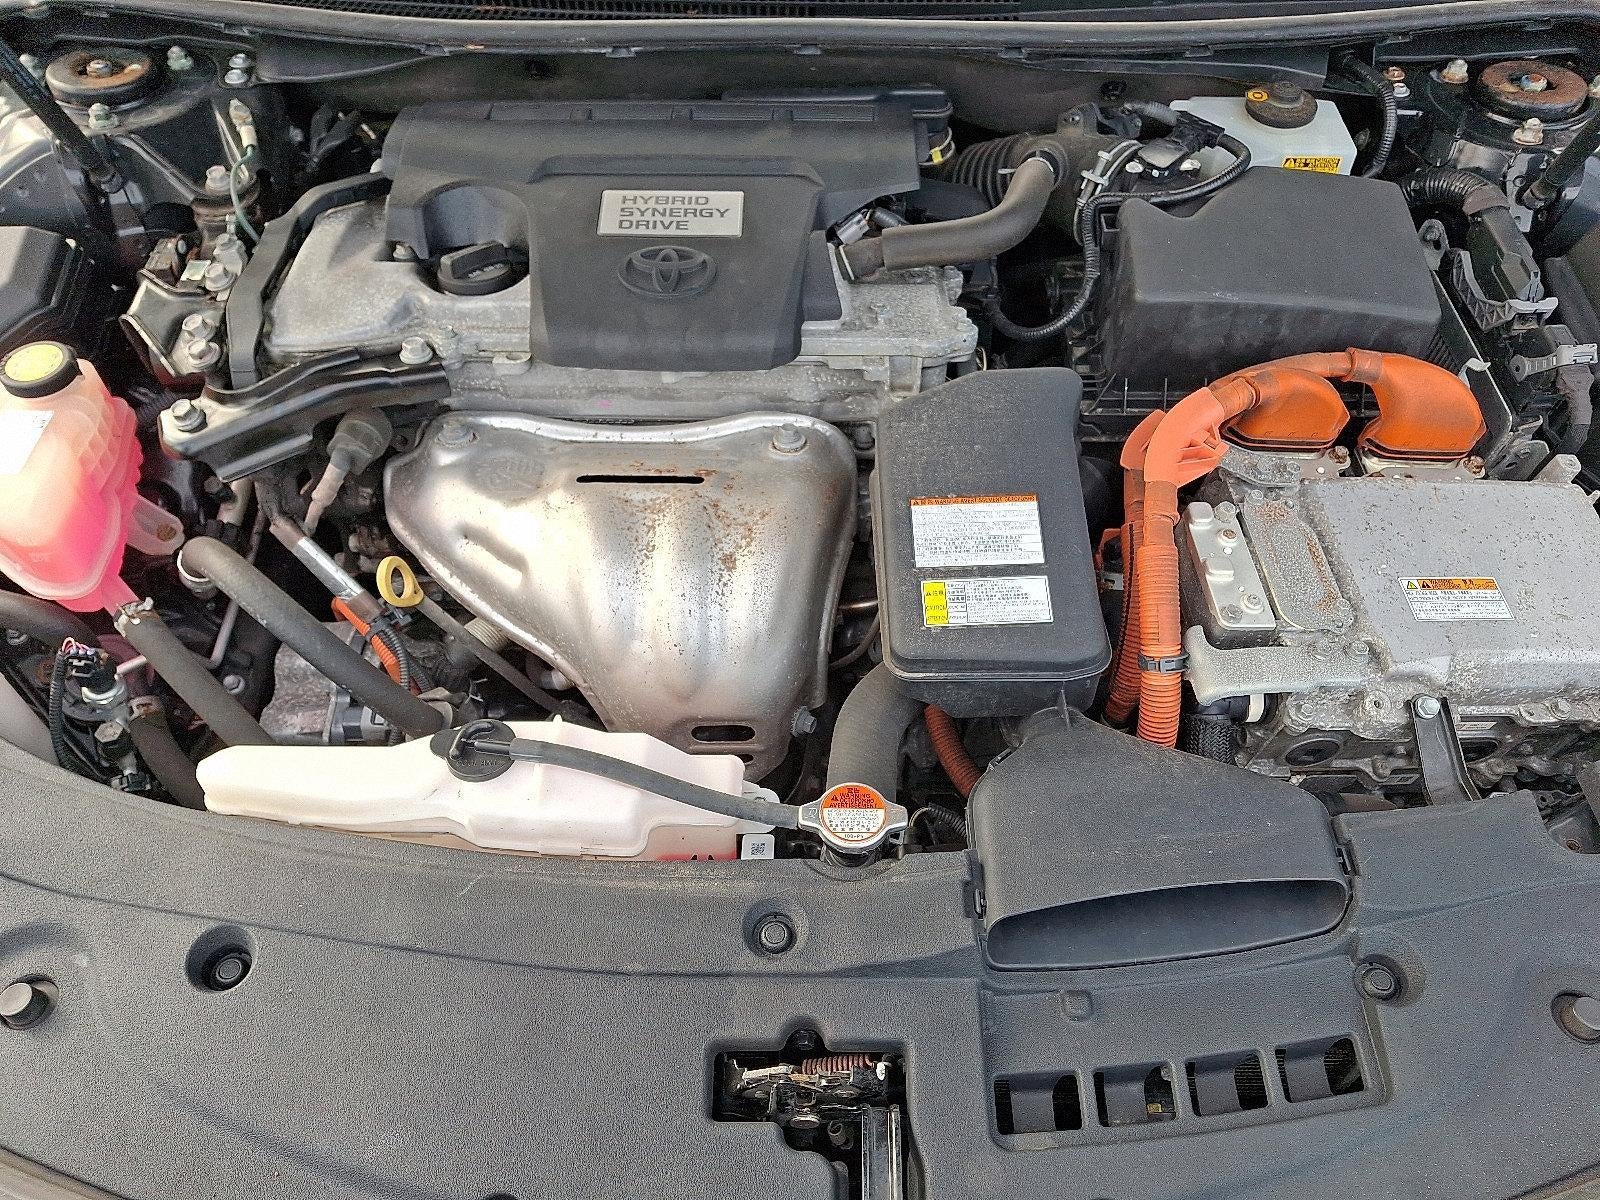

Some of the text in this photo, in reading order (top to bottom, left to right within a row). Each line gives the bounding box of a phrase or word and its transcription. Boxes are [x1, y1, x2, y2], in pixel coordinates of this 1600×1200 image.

[622, 195, 709, 206] HYBRID
[620, 207, 731, 218] SYNERGY
[618, 219, 690, 231] DRIVE
